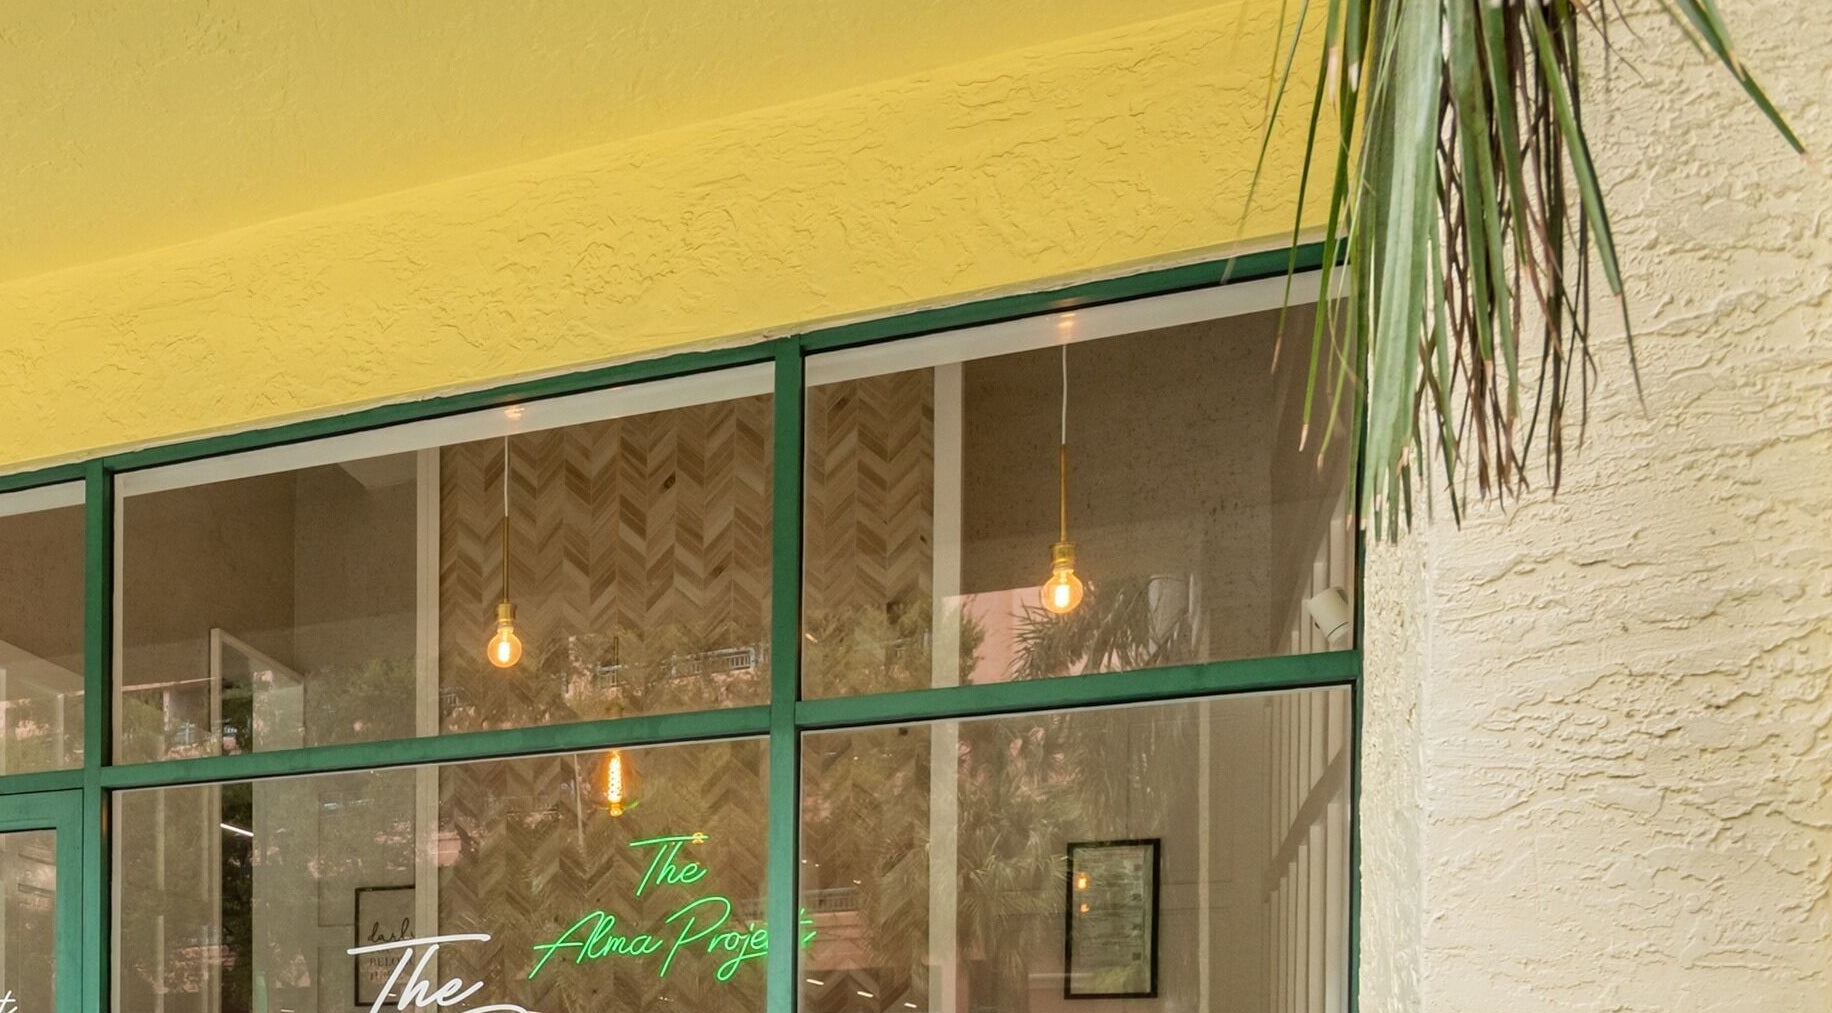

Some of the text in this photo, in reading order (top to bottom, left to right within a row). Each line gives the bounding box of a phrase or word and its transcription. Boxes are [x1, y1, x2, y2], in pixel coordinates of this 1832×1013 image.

[629, 833, 709, 897] The
[528, 896, 818, 982] Alma Proje
